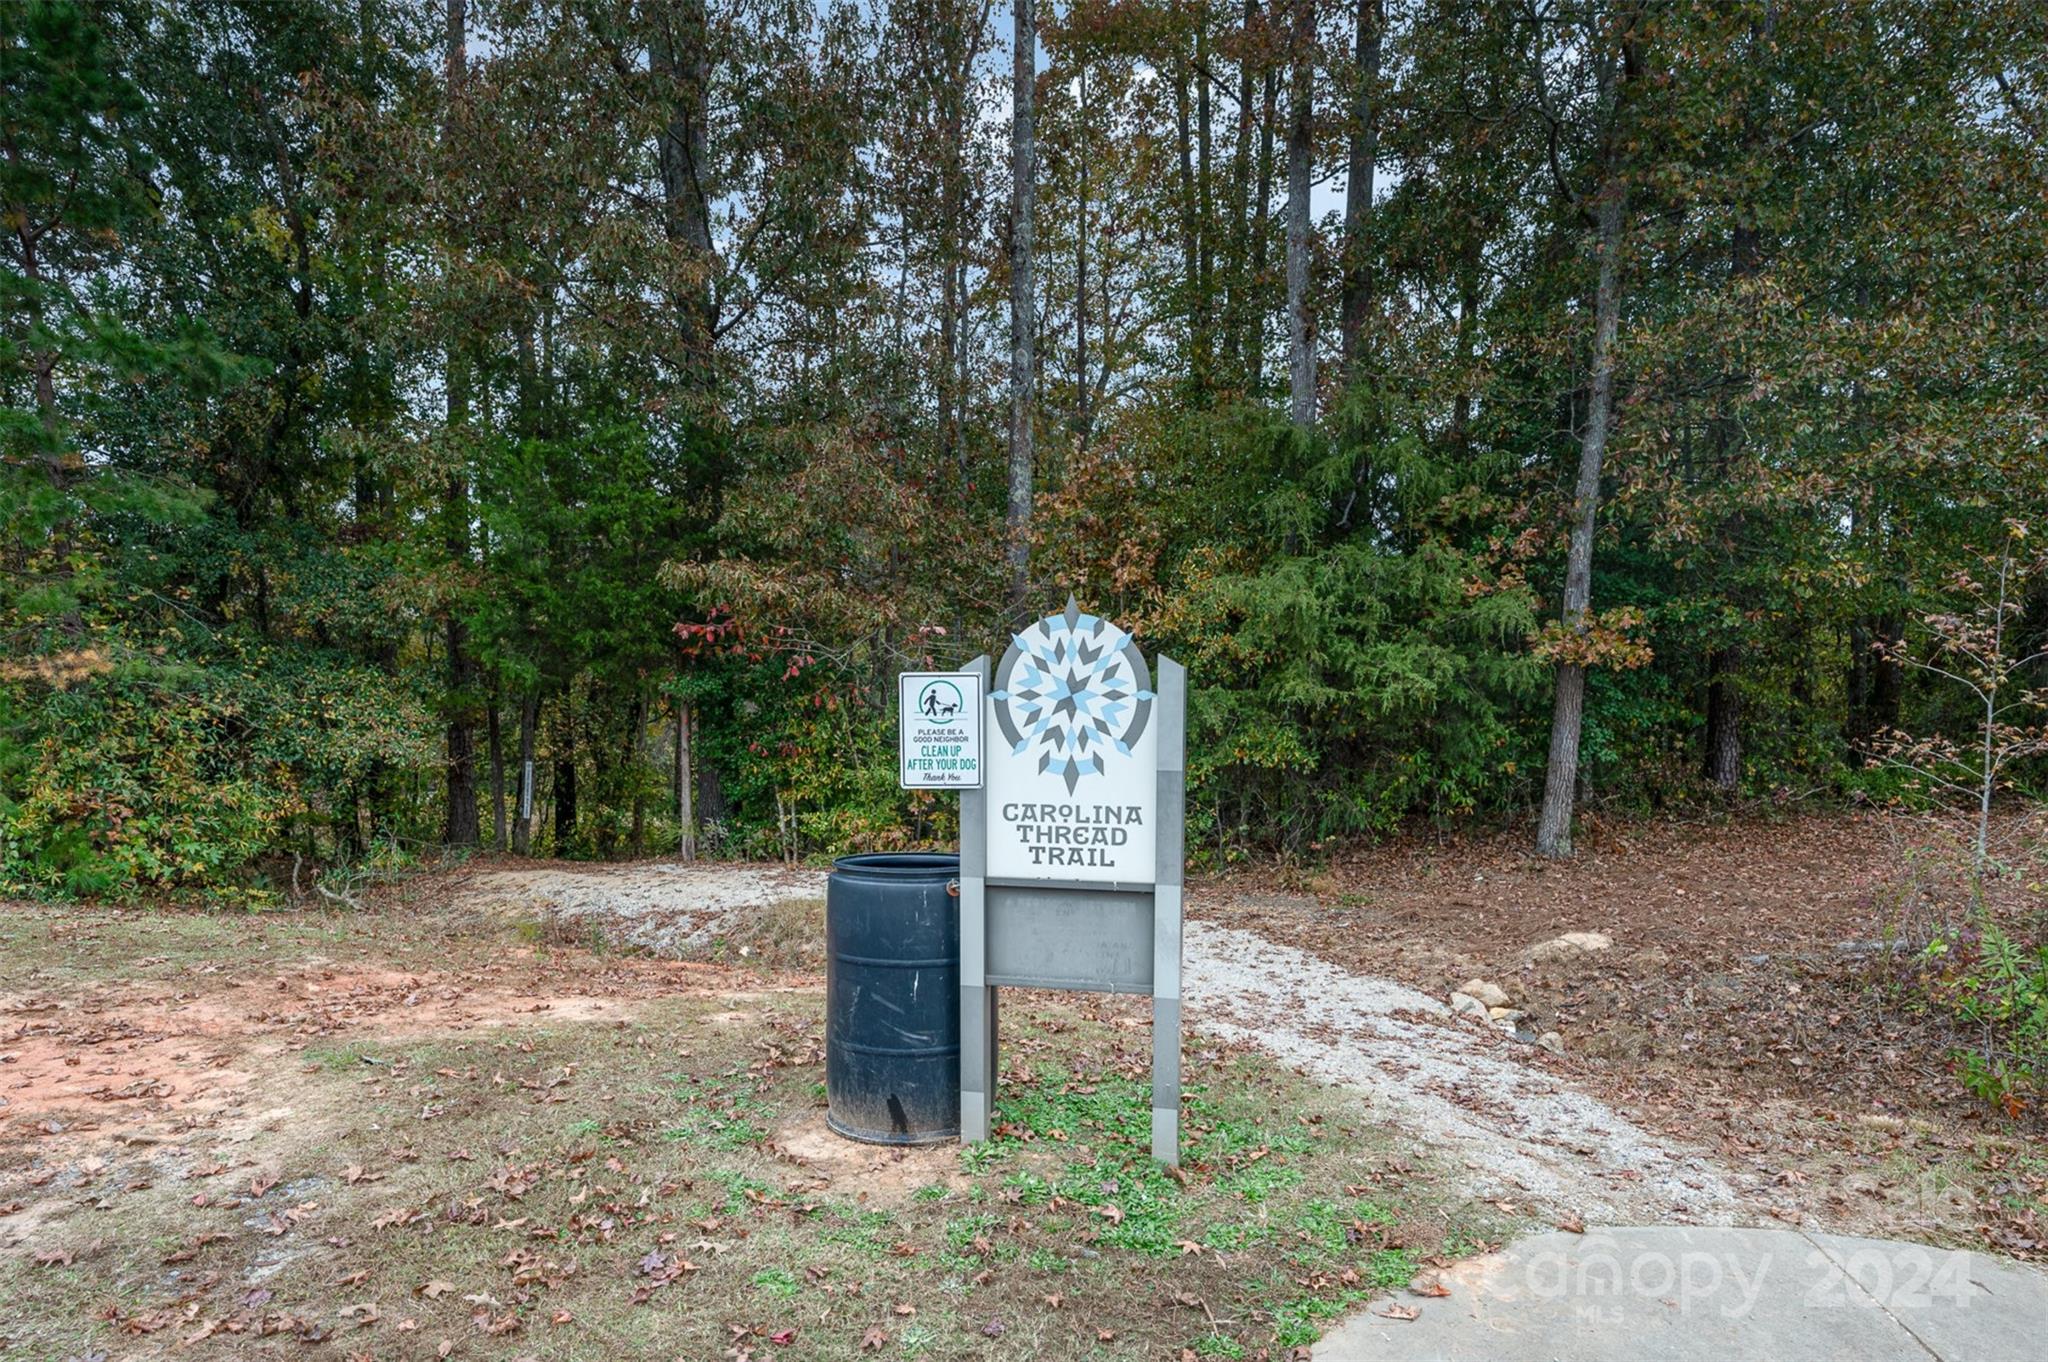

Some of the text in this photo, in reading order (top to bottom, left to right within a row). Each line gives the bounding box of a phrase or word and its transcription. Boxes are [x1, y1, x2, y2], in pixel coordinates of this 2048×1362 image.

[921, 746, 961, 757] CLEAN UP
[907, 759, 976, 770] AFTER YOUR DOG
[922, 773, 945, 781] Thank
[1002, 803, 1143, 825] CAROLINA
[1017, 824, 1128, 846] THREAD
[1029, 846, 1115, 867] TRAIL
